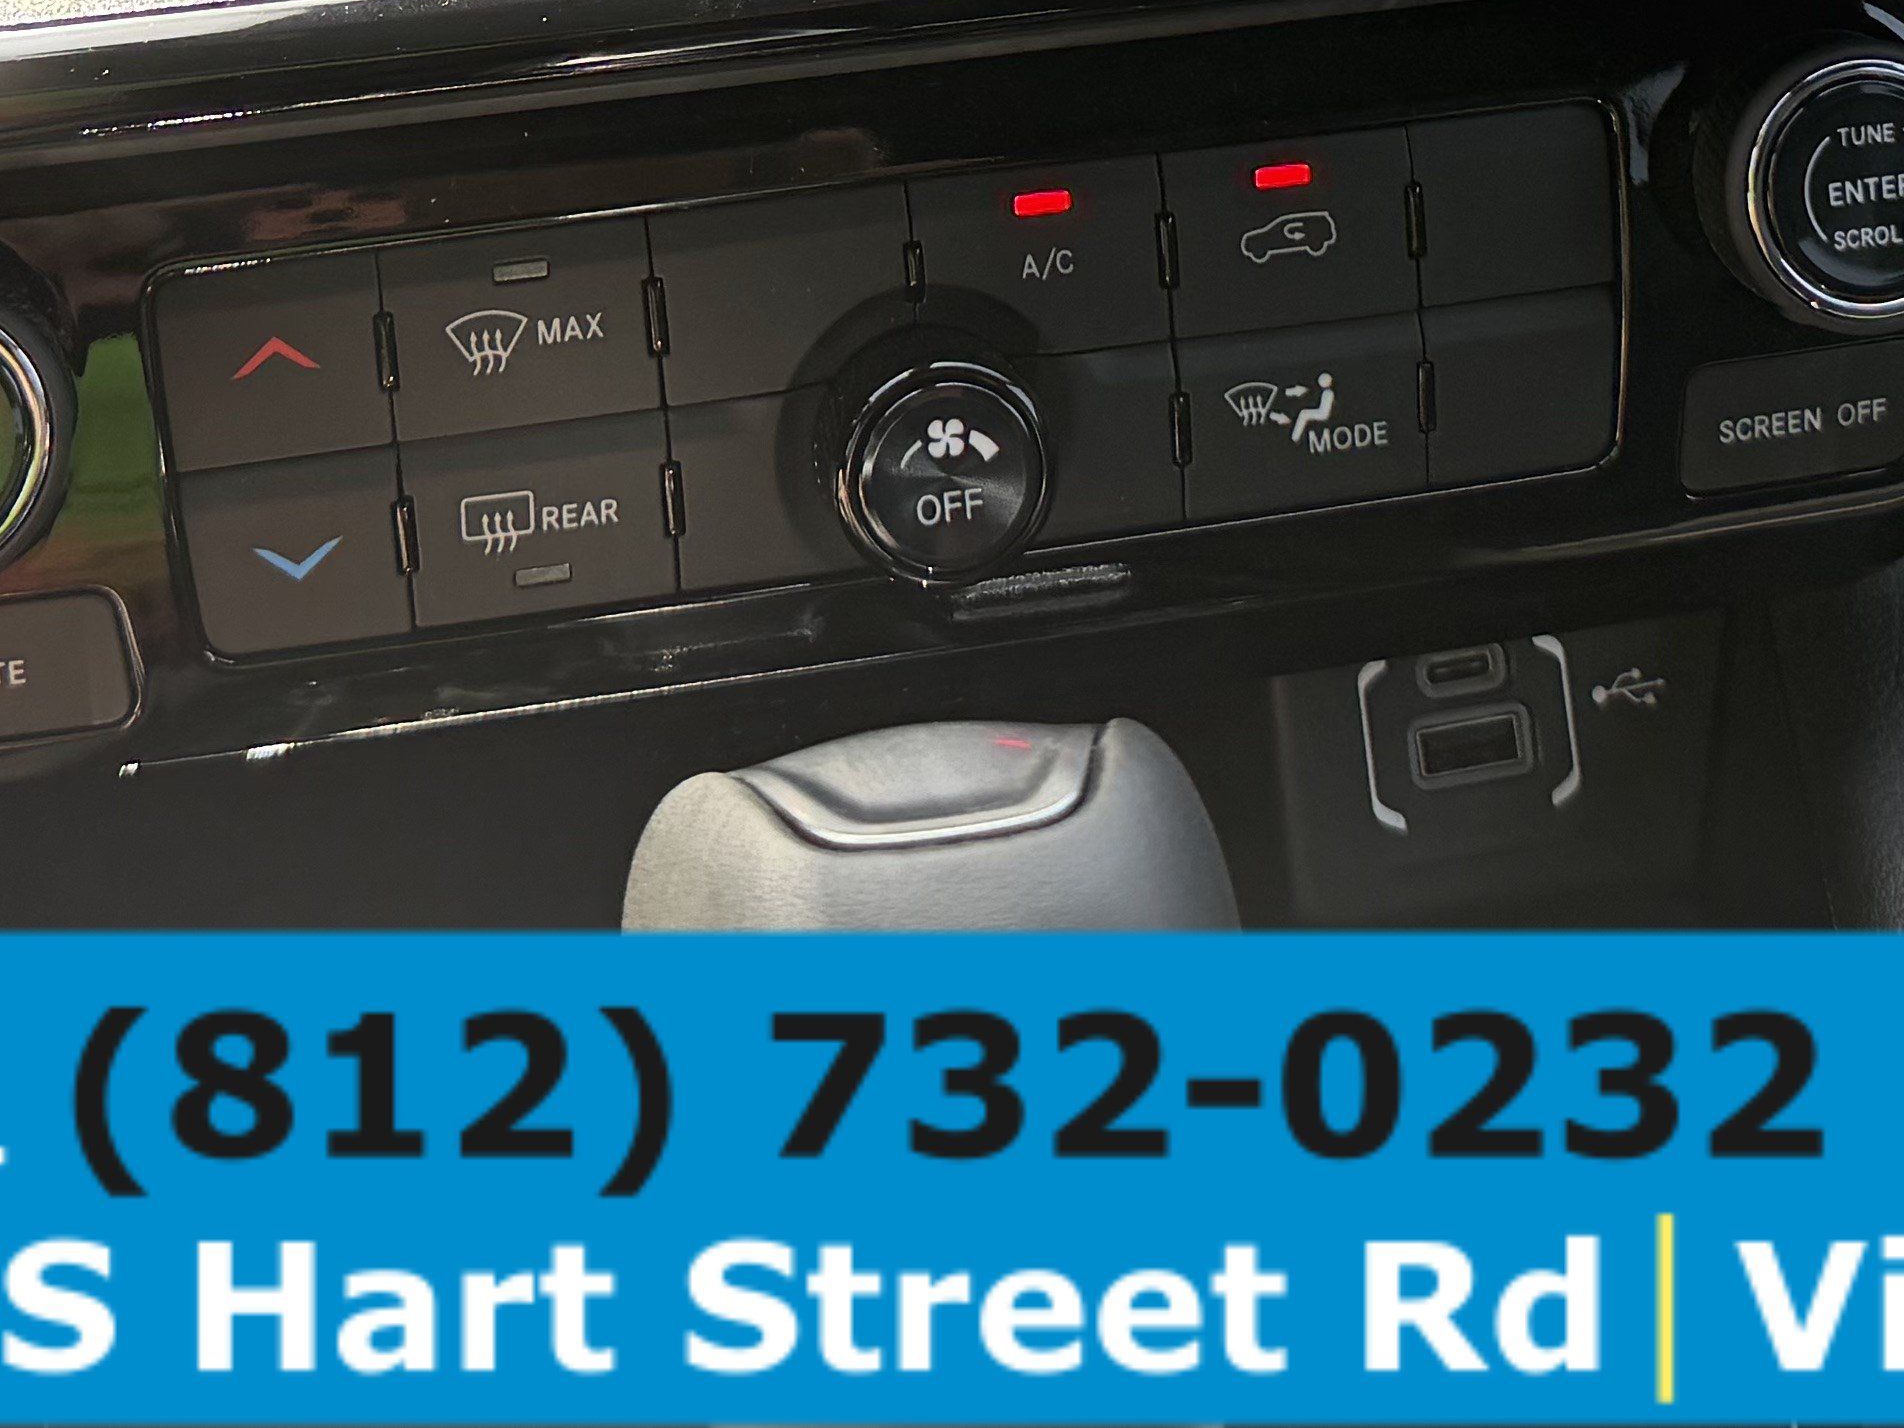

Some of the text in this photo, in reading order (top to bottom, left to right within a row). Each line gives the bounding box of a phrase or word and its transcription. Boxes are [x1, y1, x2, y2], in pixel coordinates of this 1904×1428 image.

[1835, 121, 1896, 148] TUNE
[1020, 246, 1076, 281] A/C
[536, 311, 605, 346] MAX
[1307, 419, 1389, 455] MODE
[1718, 395, 1888, 445] SCREEN OFF
[540, 497, 620, 532] REAR
[915, 487, 985, 527] OFF
